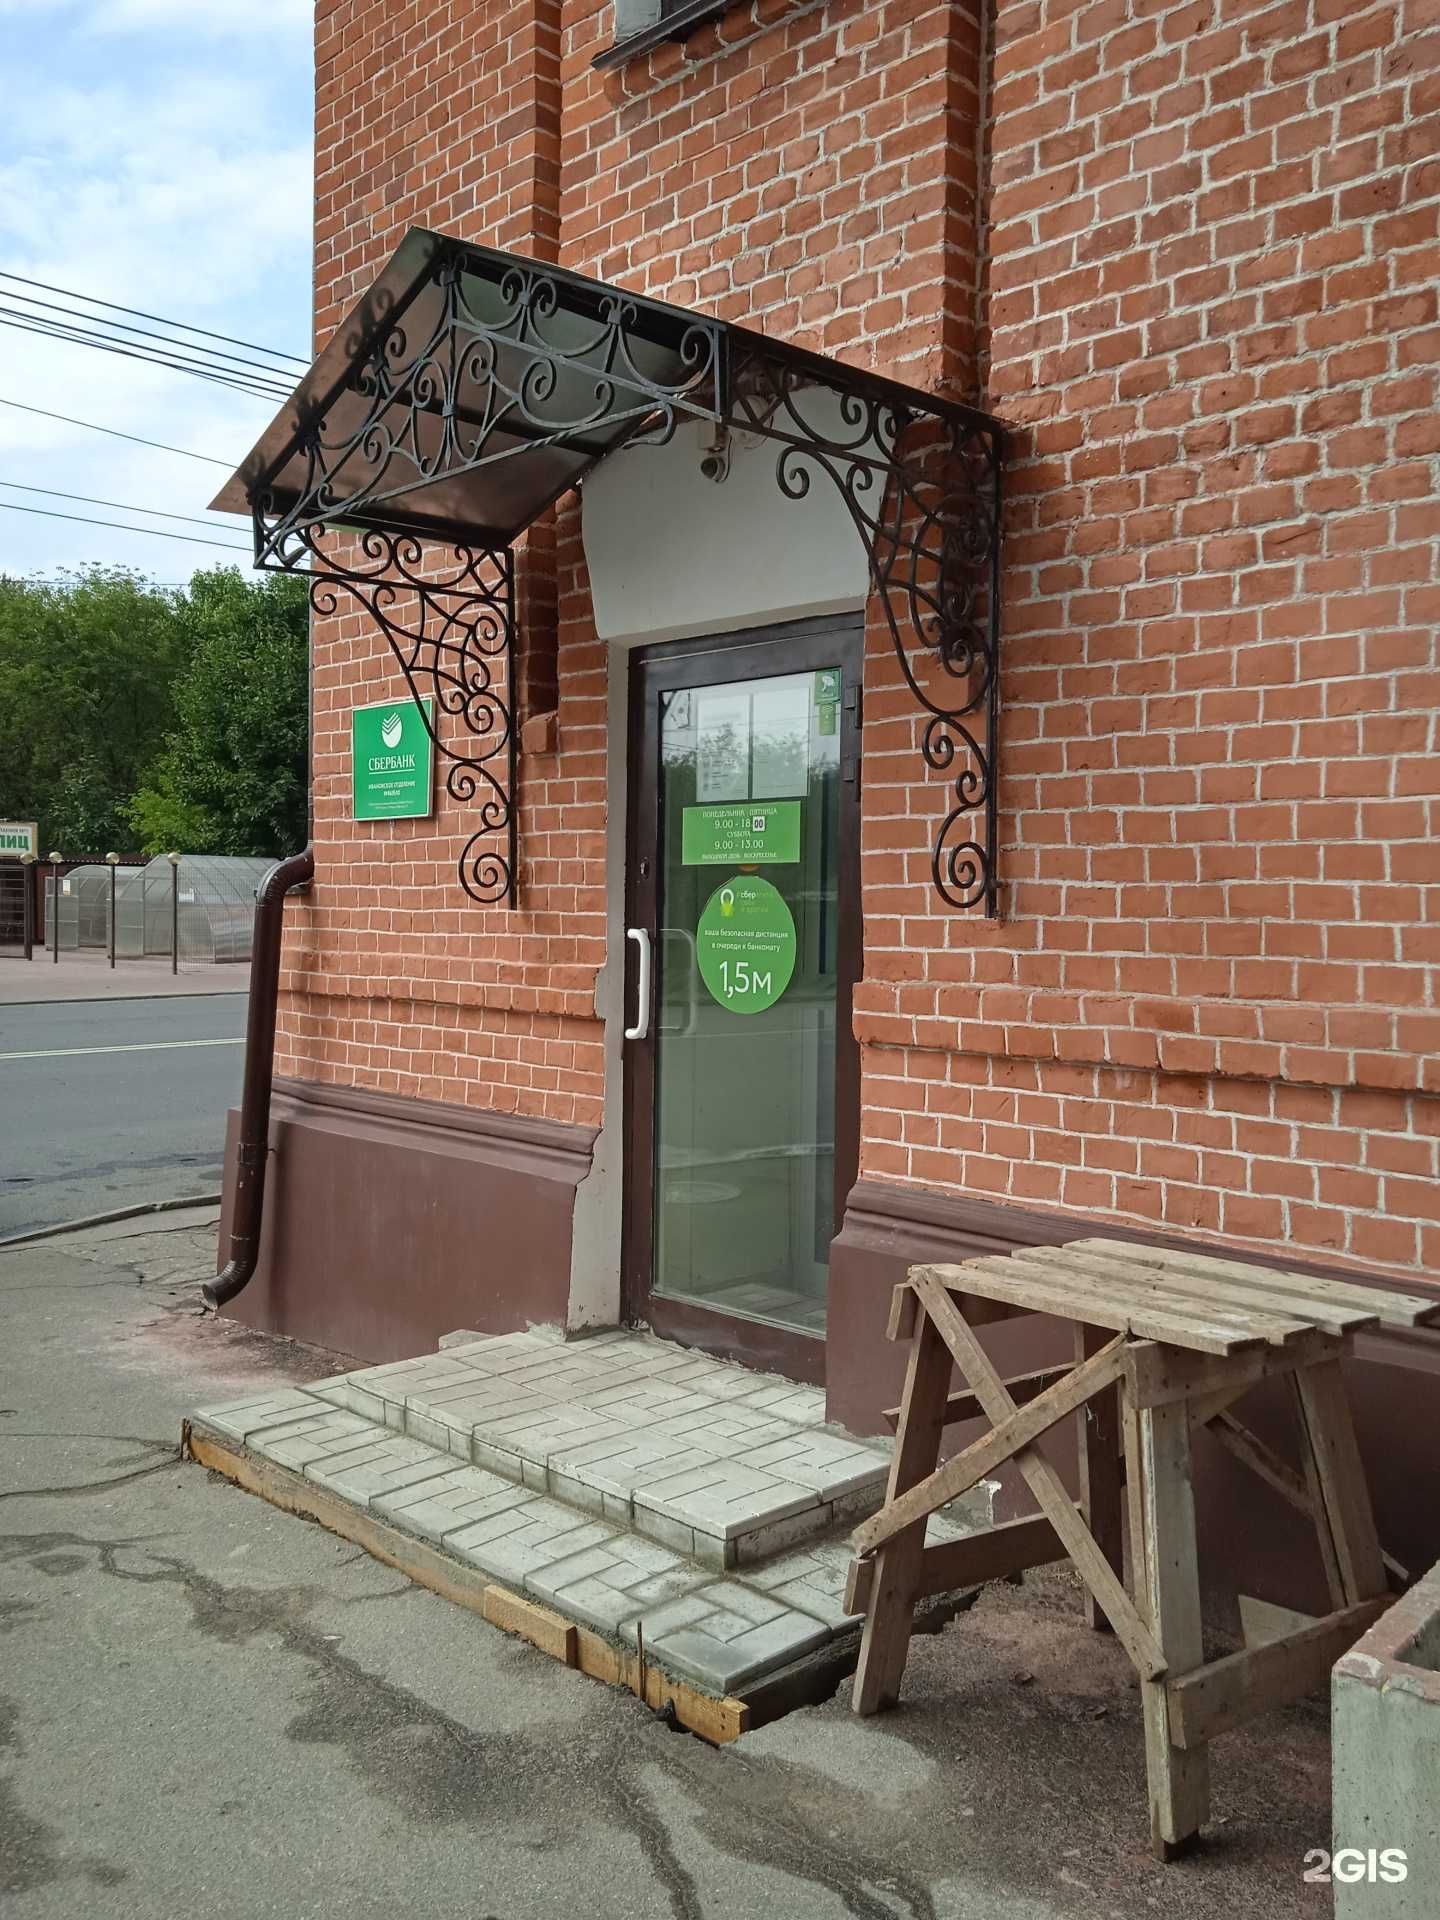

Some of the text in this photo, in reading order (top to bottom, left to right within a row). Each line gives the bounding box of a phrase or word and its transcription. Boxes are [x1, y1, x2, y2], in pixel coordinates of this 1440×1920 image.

[368, 754, 415, 771] СБЕРБАНК
[714, 819, 733, 829] 9.00
[714, 840, 733, 850] 9.00
[741, 839, 764, 849] 13.00
[720, 928, 754, 937] безопасная
[755, 930, 789, 938] дистанция
[716, 943, 741, 951] очереди
[747, 942, 781, 952] банкомату
